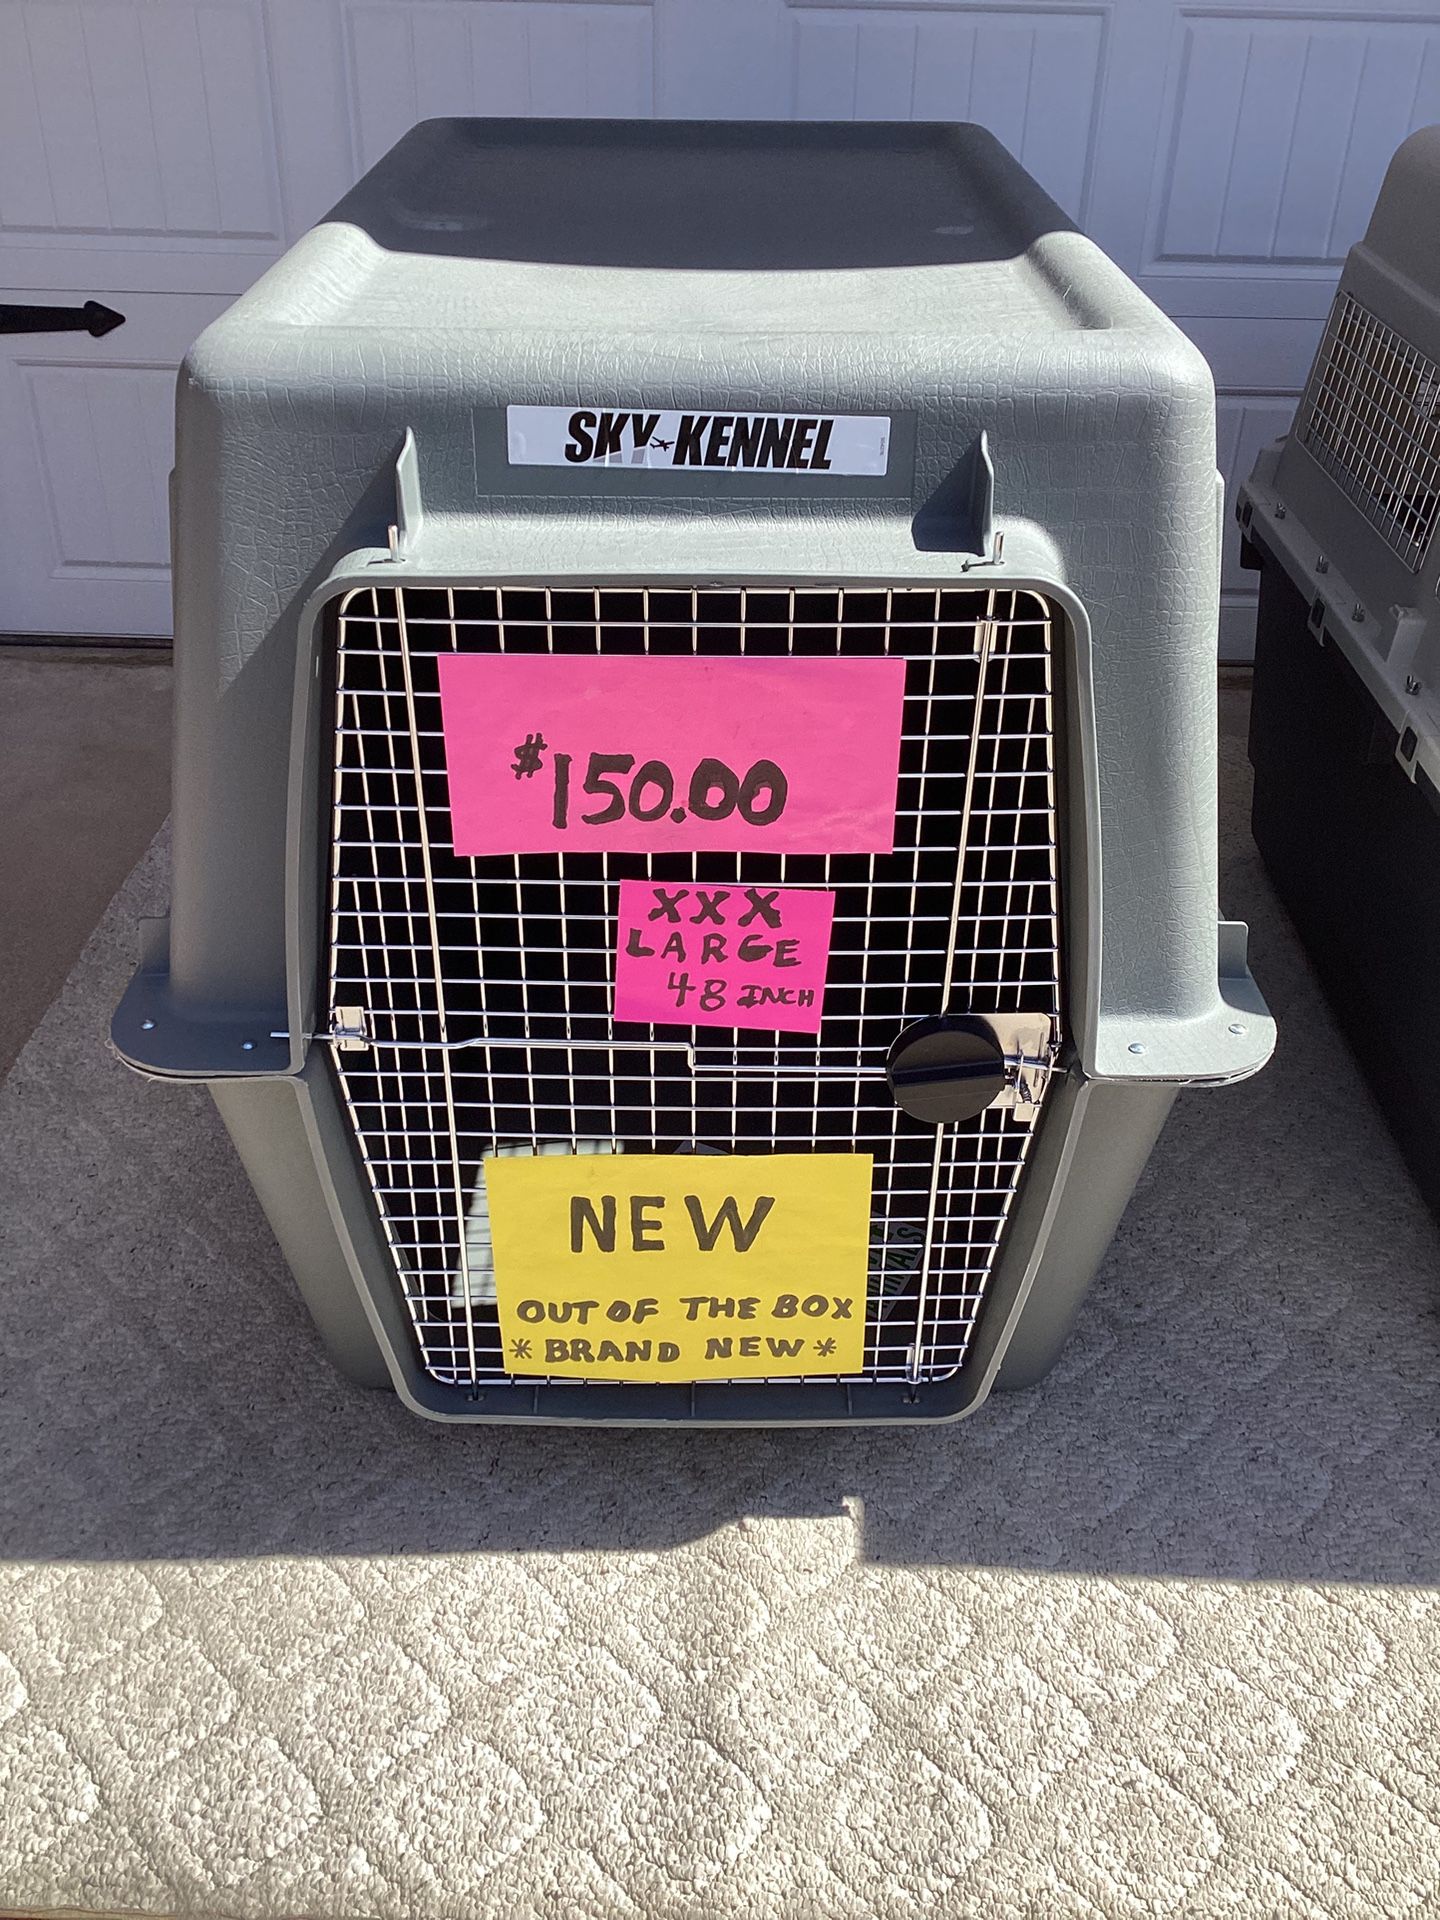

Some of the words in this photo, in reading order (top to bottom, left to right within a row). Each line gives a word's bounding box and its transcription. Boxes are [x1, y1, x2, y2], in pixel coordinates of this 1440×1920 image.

[565, 411, 661, 463] SKY
[672, 415, 834, 469] KENNEL
[511, 733, 787, 829] $150.00
[626, 928, 801, 967] LARGE
[668, 973, 726, 1011] 48
[737, 984, 815, 1008] INCH
[571, 1195, 775, 1253] NEW
[517, 1300, 599, 1324] OUT
[607, 1298, 658, 1324] OF
[680, 1297, 760, 1321] THE
[771, 1295, 853, 1319] BOX
[545, 1339, 680, 1363] BRAND
[705, 1337, 804, 1359] NEW
